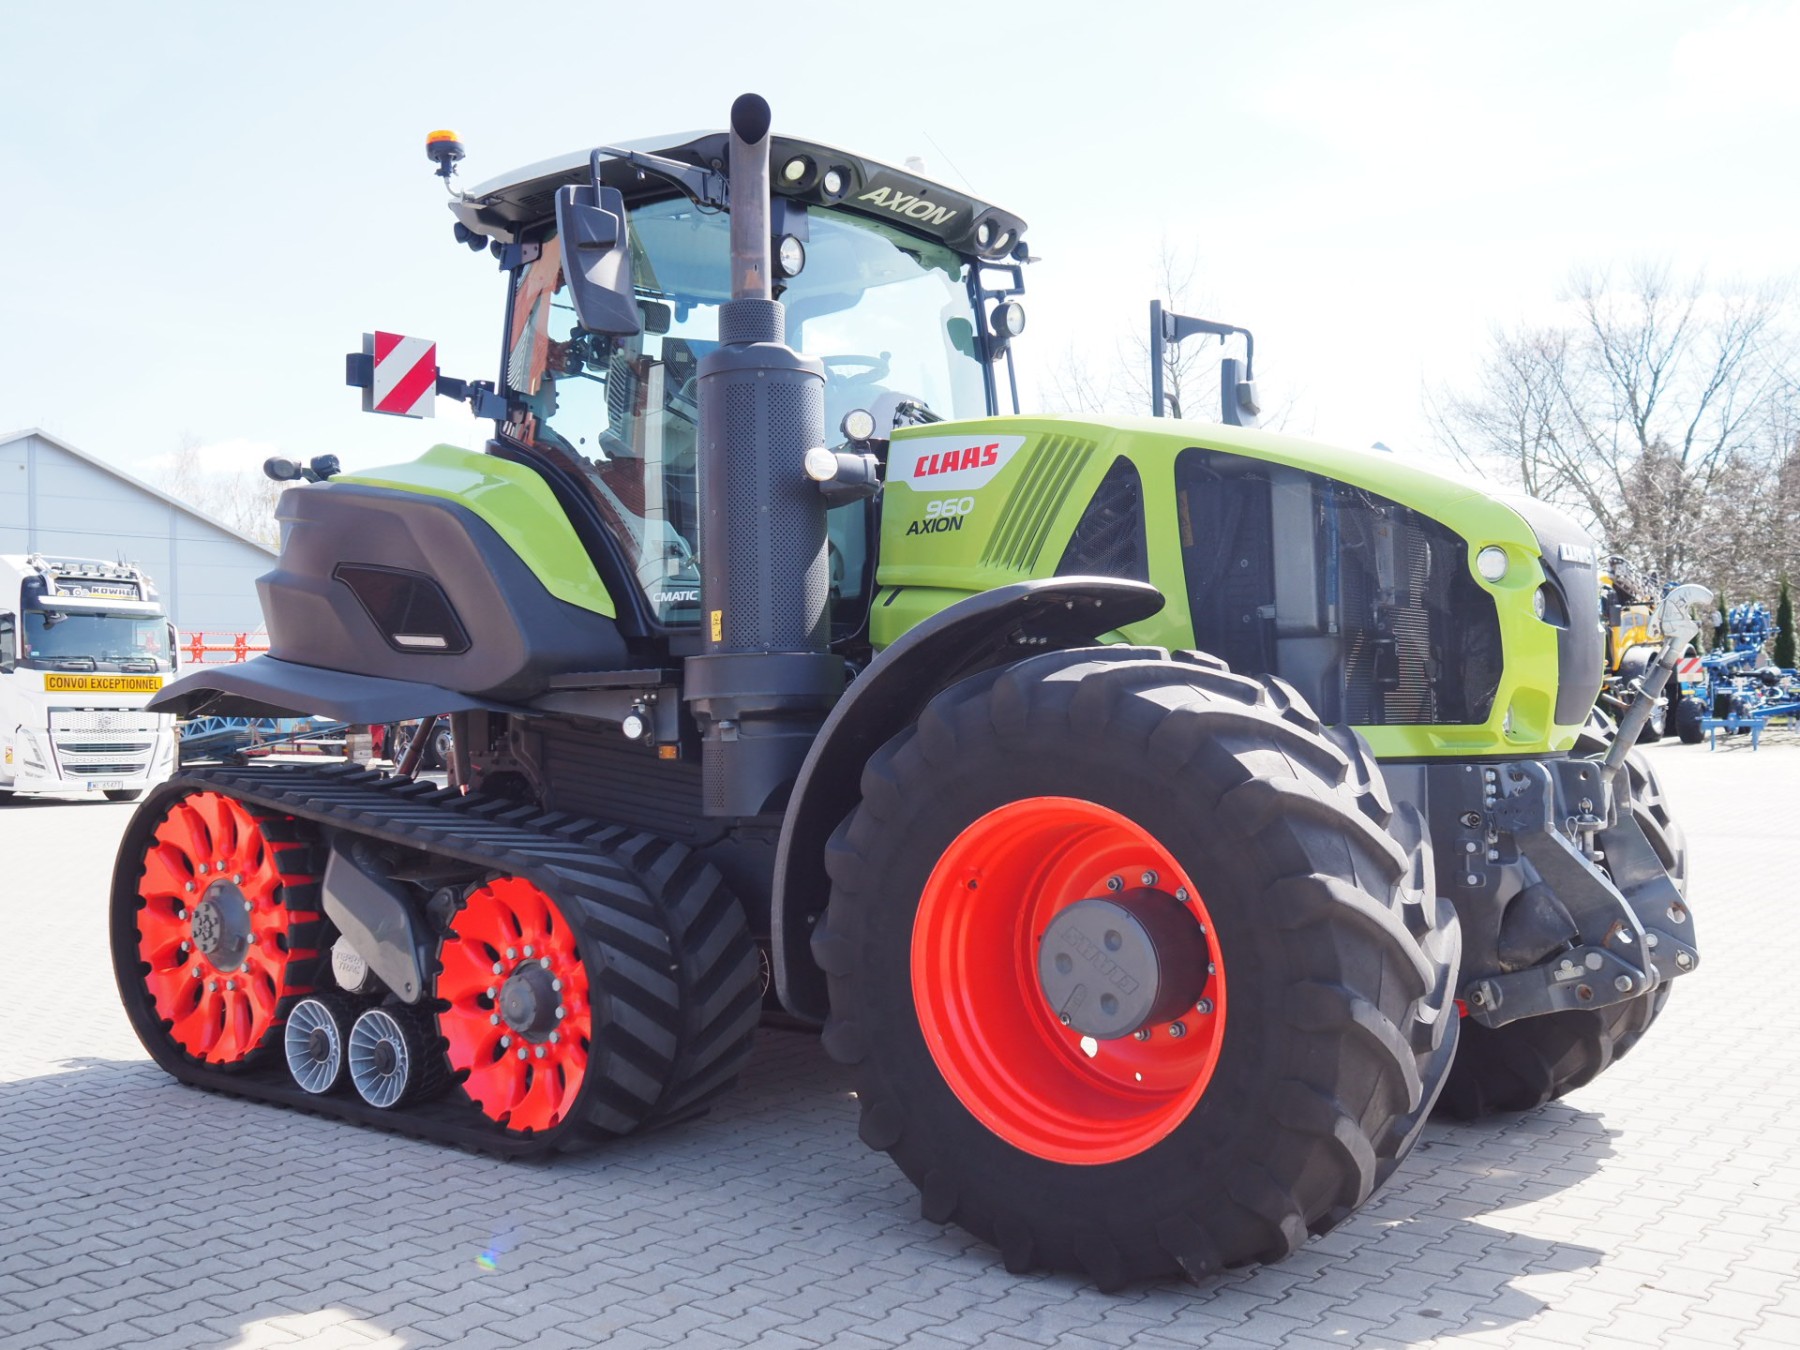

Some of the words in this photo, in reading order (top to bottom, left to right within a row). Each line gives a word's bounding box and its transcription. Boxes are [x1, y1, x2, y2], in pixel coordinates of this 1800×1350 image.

[858, 186, 958, 226] AXION
[913, 443, 1000, 478] CLAAS
[925, 496, 975, 519] 960
[906, 515, 964, 536] AXION
[653, 590, 699, 602] CMATIC
[49, 677, 88, 689] CONVOI
[90, 678, 160, 690] EXCEPTIONNEL
